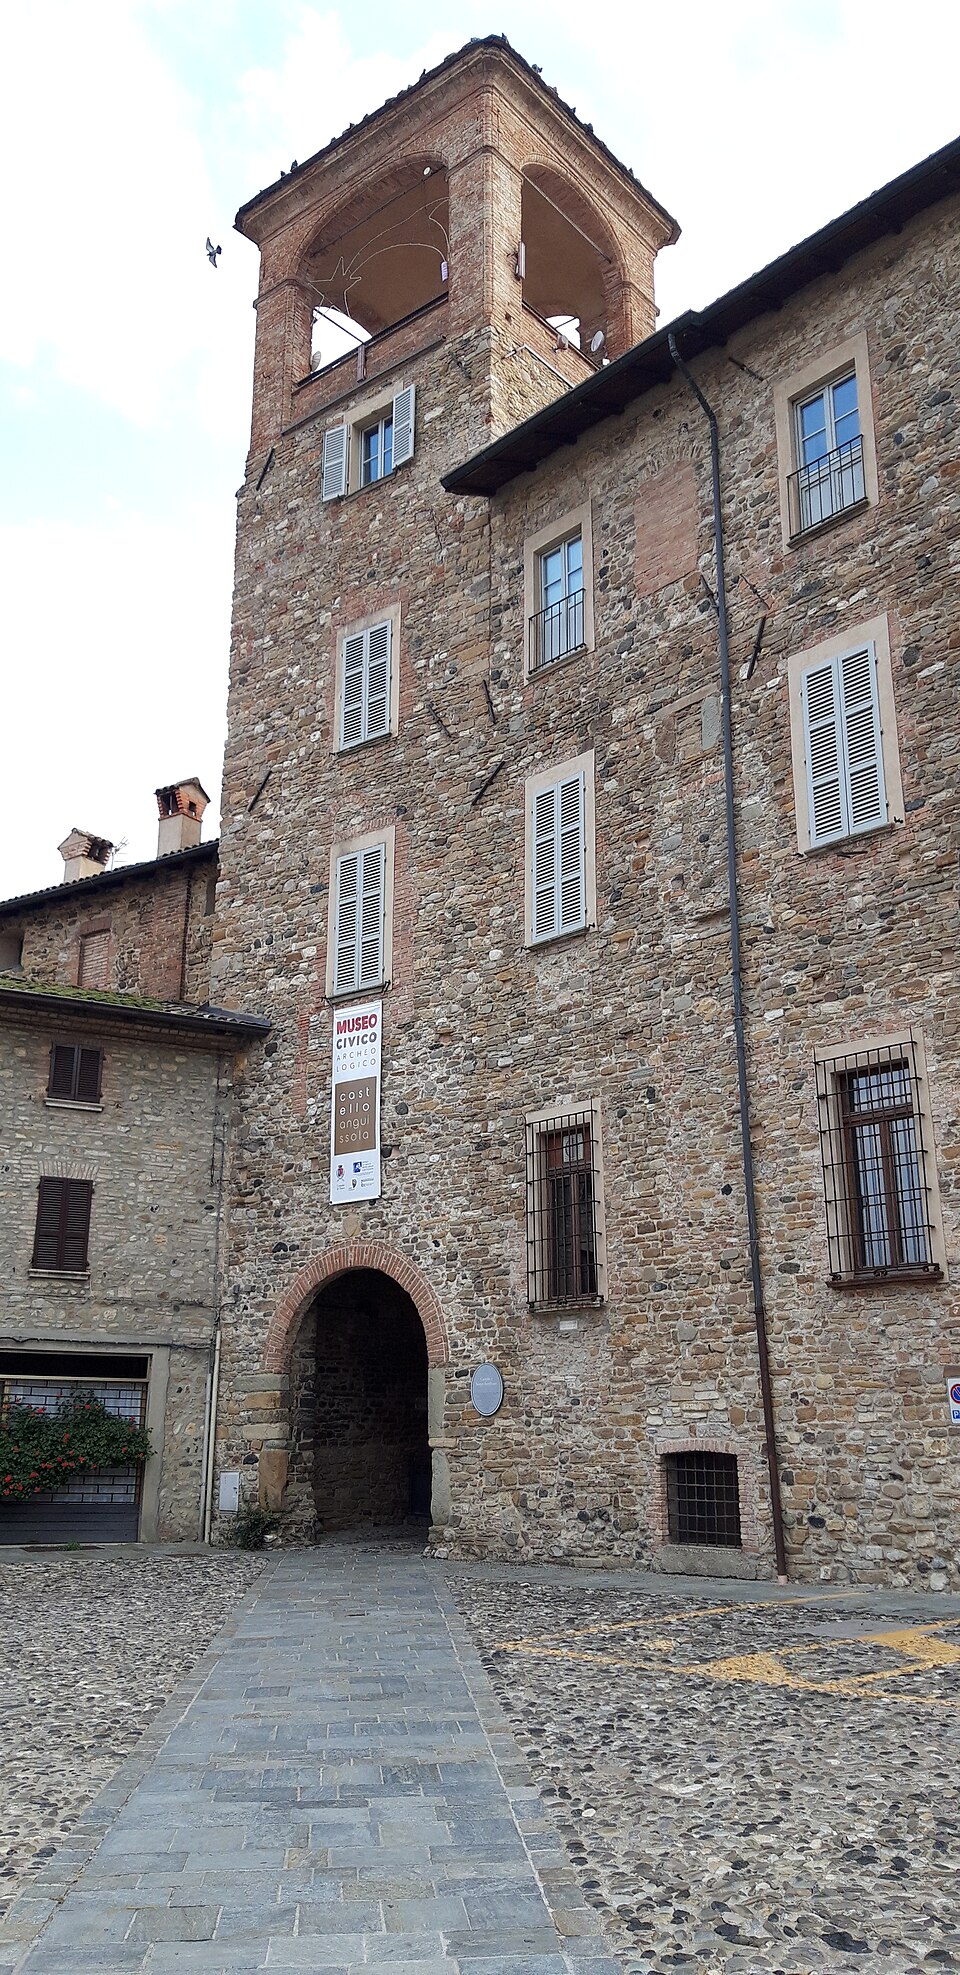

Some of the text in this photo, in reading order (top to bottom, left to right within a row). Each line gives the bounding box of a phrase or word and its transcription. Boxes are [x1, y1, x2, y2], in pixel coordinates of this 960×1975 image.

[336, 1013, 378, 1035] MUSEO
[336, 1031, 378, 1050] CIVICO
[336, 1047, 377, 1062] ARCHEO
[336, 1058, 377, 1073] LOGICO
[339, 1102, 371, 1116] ello
[339, 1114, 370, 1130] angui
[339, 1130, 370, 1144] ssola
